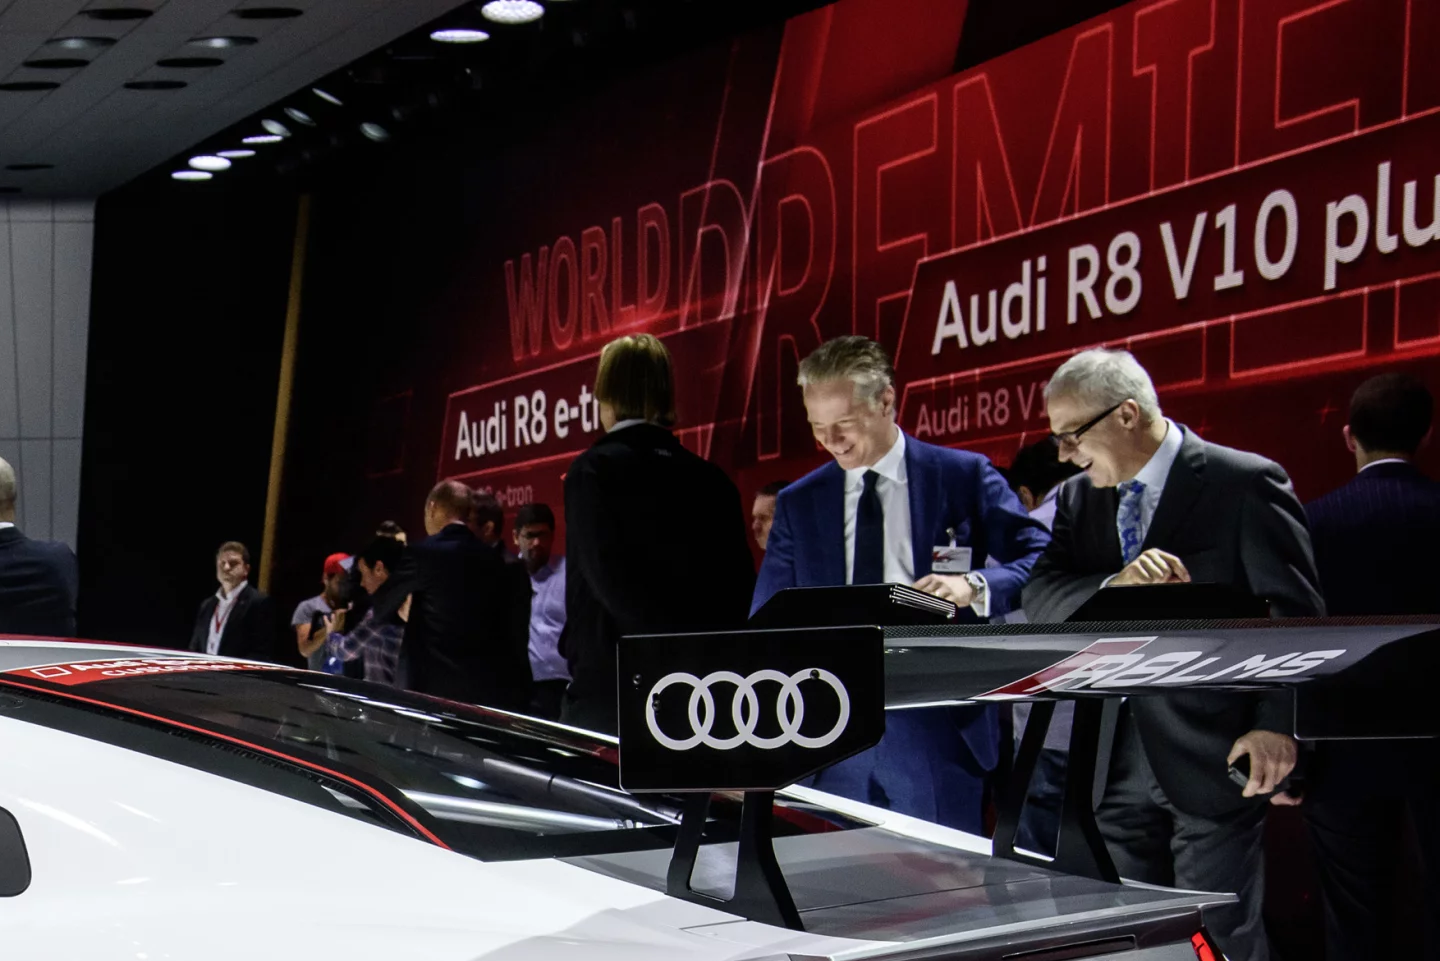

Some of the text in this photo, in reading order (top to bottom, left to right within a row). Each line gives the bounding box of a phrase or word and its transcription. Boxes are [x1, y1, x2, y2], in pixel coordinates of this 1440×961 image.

[504, 202, 670, 361] WORLD
[931, 255, 1047, 356] Audi
[1067, 231, 1142, 325] R8
[1160, 188, 1300, 301] V10
[455, 384, 599, 460] Audi R8 e-tr
[915, 380, 1050, 437] Audi R8 V1
